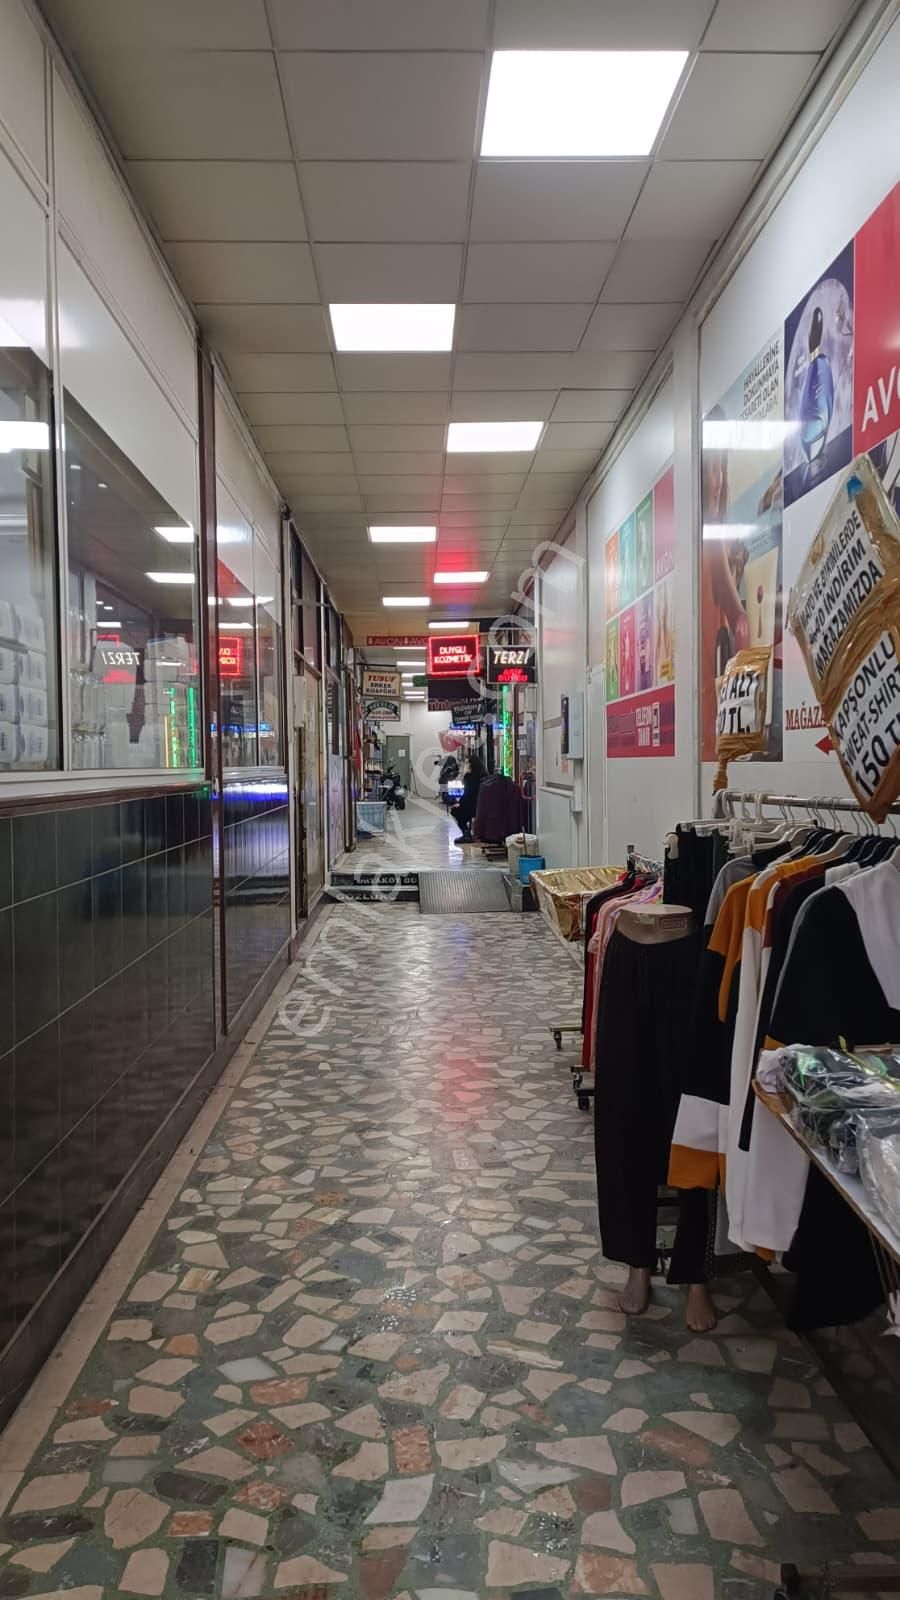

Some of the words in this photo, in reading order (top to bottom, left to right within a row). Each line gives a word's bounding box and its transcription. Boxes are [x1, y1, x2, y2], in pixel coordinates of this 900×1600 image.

[861, 363, 900, 432] AV
[440, 645, 466, 655] DUYGU
[814, 559, 883, 677] MAĞAZAMIZDA
[854, 734, 890, 798] 150
